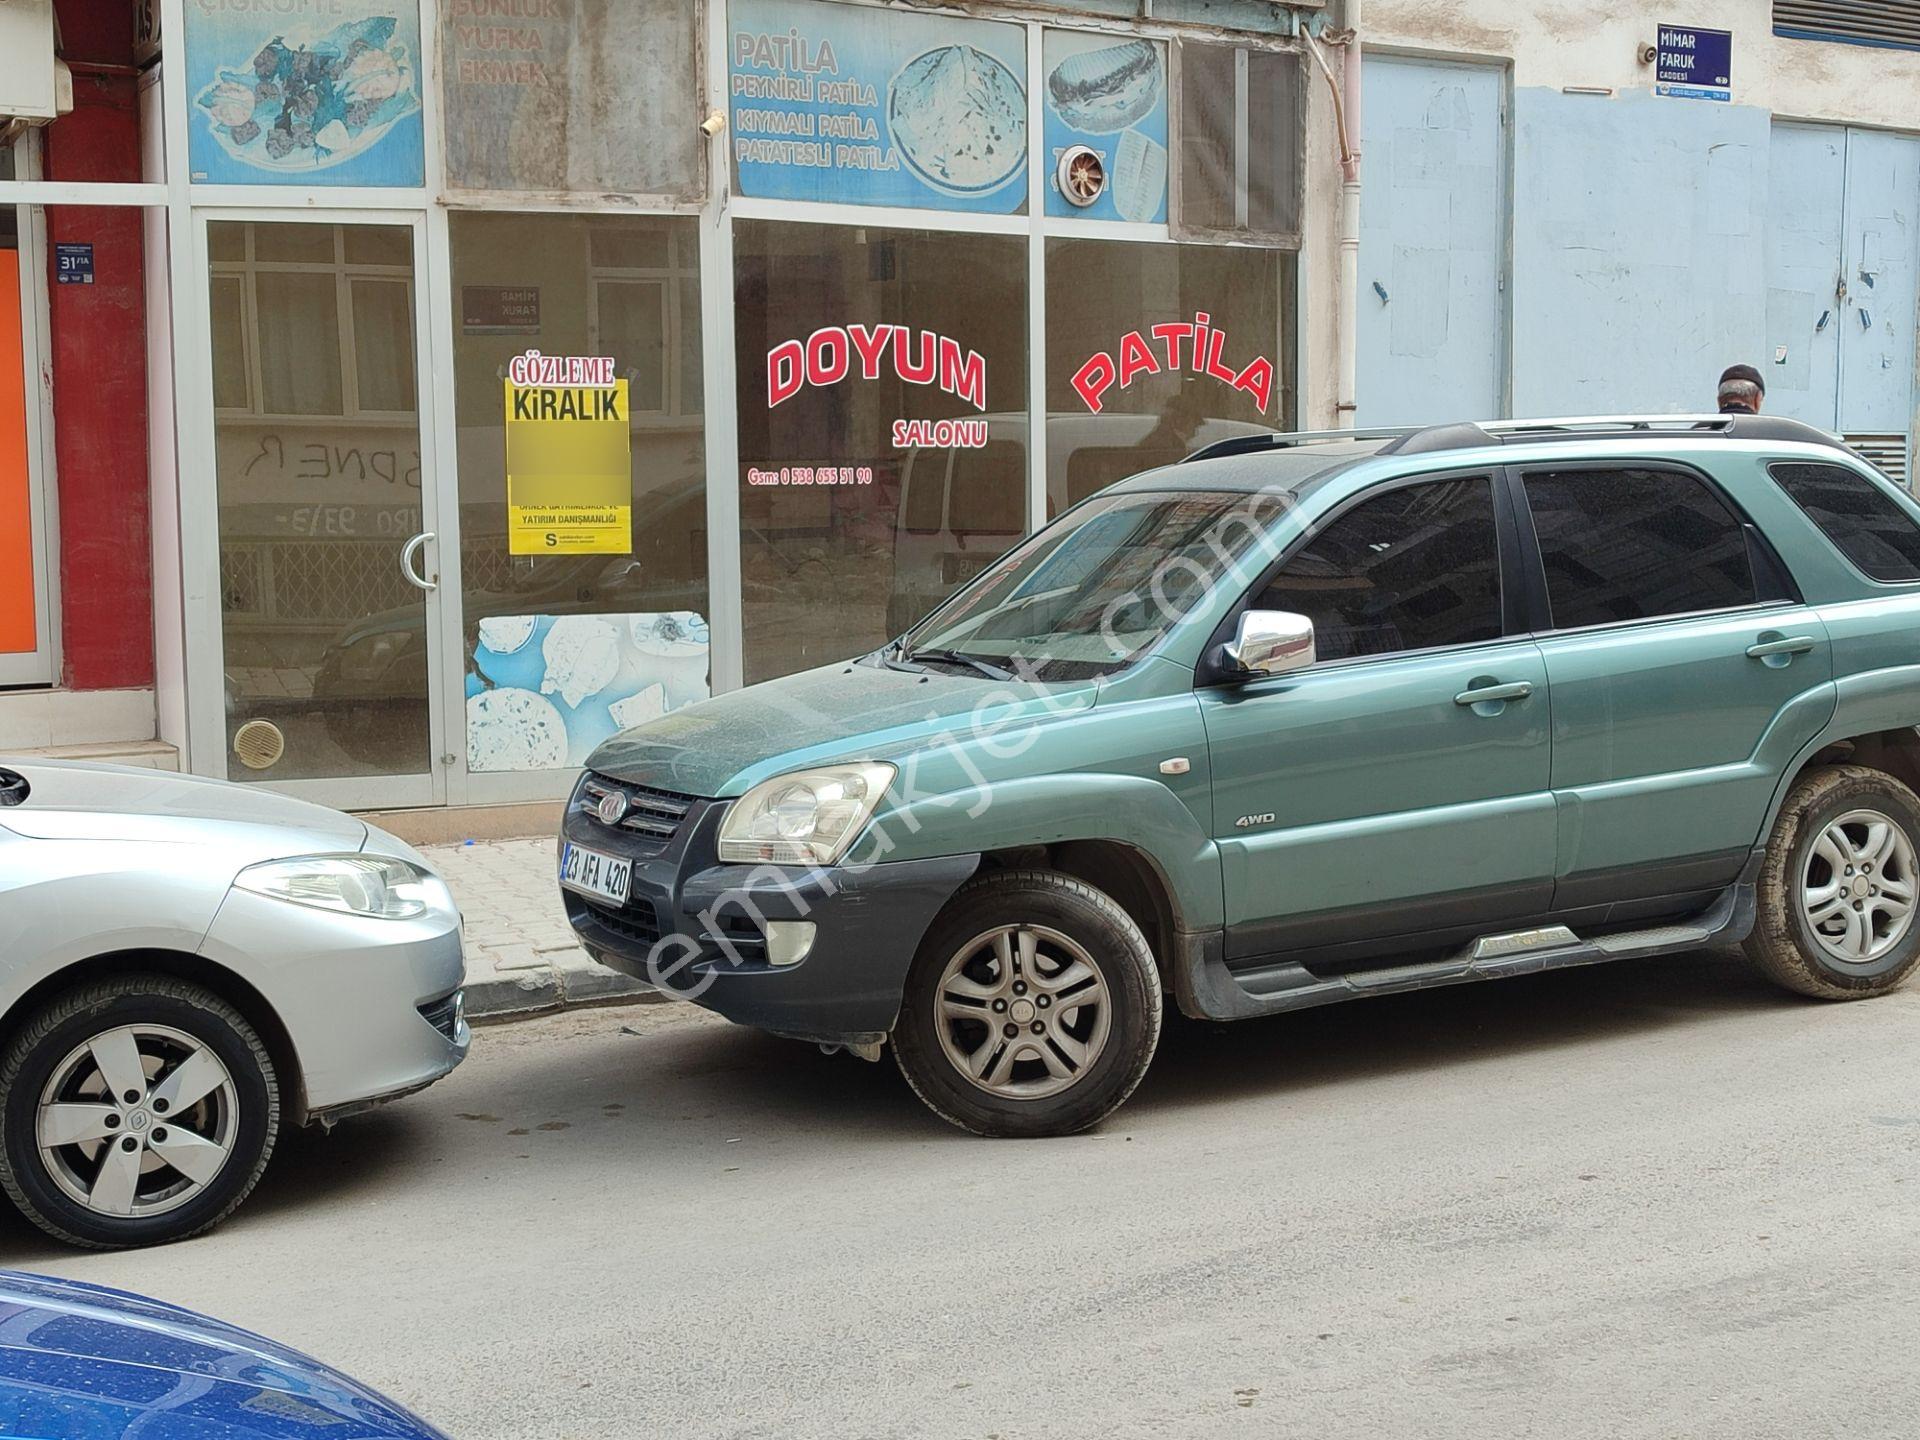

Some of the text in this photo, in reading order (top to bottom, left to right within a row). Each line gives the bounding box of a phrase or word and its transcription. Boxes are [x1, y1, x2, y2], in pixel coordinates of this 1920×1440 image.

[458, 27, 543, 50] YUFKA
[735, 28, 838, 75] PATİLA
[1660, 30, 1696, 49] MİMAR
[460, 60, 547, 86] EKMEK
[1660, 52, 1695, 69] FARUK
[732, 71, 878, 107] PEYNİRLİ PATİLA
[736, 108, 879, 141] KIYMALI PATİLA
[735, 138, 899, 171] PATATESLİ PATİLA
[510, 350, 615, 386] GÖZLEME
[767, 324, 985, 411] DOYUM
[1070, 311, 1274, 416] PATİLA
[892, 419, 988, 448] SALONU
[748, 467, 873, 485] Gsm: 0 538 655 51 90
[522, 514, 557, 525] YATIRIM
[545, 533, 558, 547] S
[1235, 812, 1276, 827] 4WD
[567, 848, 628, 897] 23 AFA 420
